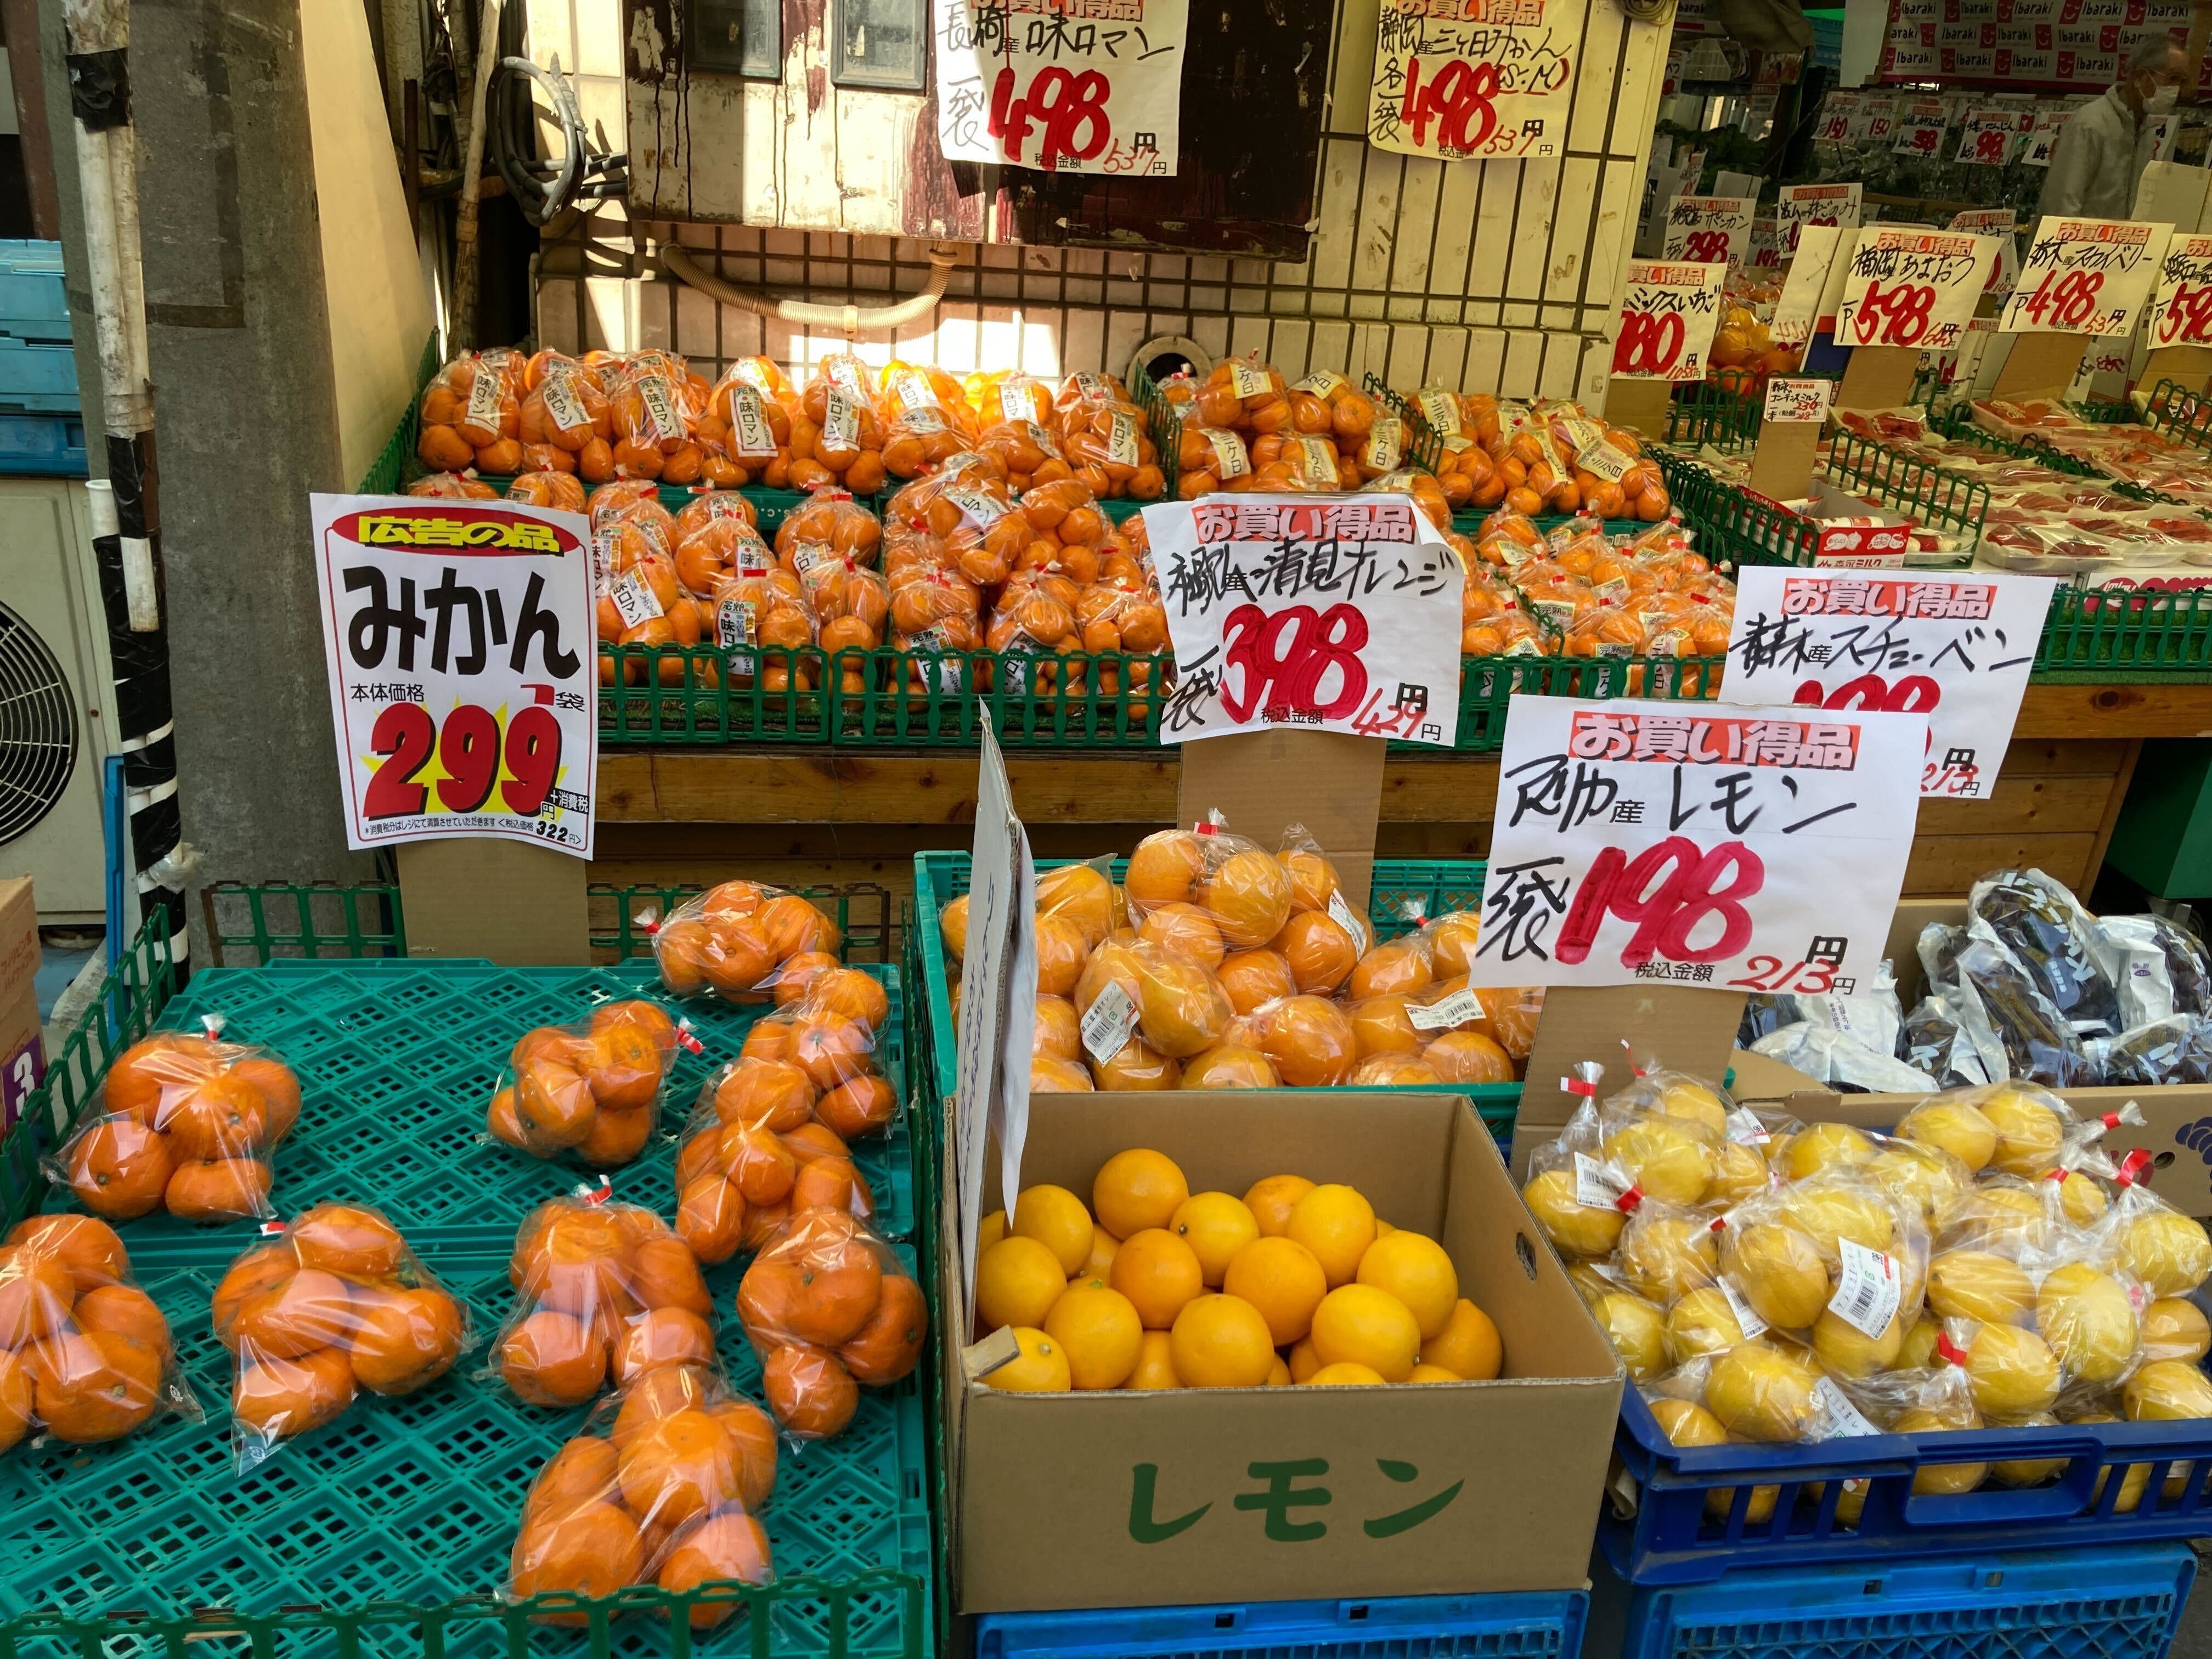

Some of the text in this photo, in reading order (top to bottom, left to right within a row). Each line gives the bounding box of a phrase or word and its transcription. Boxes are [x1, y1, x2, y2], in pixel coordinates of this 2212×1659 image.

[1902, 2, 1936, 14] Ibaraki
[2015, 2, 2054, 14] Ibaraki
[2083, 2, 2123, 16] Ibaraki
[2147, 3, 2189, 18] Ibaraki
[1942, 27, 1977, 40] Ibaraki
[2058, 30, 2095, 43] Ibaraki
[1897, 52, 1932, 64] Ibaraki
[1956, 54, 1991, 66] Ibaraki
[2012, 54, 2047, 67] Ibaraki
[2075, 56, 2114, 71] Ibaraki
[988, 66, 1110, 170] 498
[1401, 57, 1498, 149] 498
[1681, 230, 1730, 263] 298
[1877, 233, 1974, 257] お買い得品
[2057, 223, 2152, 245] お買い得品
[1853, 280, 1936, 347] 598
[2025, 269, 2104, 325] 498
[471, 375, 492, 414] 味ロマン
[546, 391, 572, 426] 味ロマン
[646, 393, 673, 437] 味ロマン
[740, 400, 759, 447] 味ロマン
[1112, 417, 1127, 459] 味ロマン
[358, 515, 561, 554] 広告の品
[1197, 506, 1415, 544] お買い得品
[613, 583, 641, 624] 味ロマン
[722, 601, 744, 612] 完熟
[1541, 606, 1562, 616] 完熟
[1782, 579, 1993, 620] お買い得品
[342, 565, 582, 680] みかん
[1221, 603, 1369, 724] 398
[1598, 645, 1622, 656] 完熟
[351, 682, 425, 703] 本体価格
[1261, 707, 1324, 725] 税込金額
[1572, 713, 1855, 770] お買い得品
[363, 702, 563, 821] 299 円
[1555, 836, 1848, 968] 198 円
[1634, 962, 1716, 983] 税込金額
[1128, 1458, 1465, 1544] レモン
